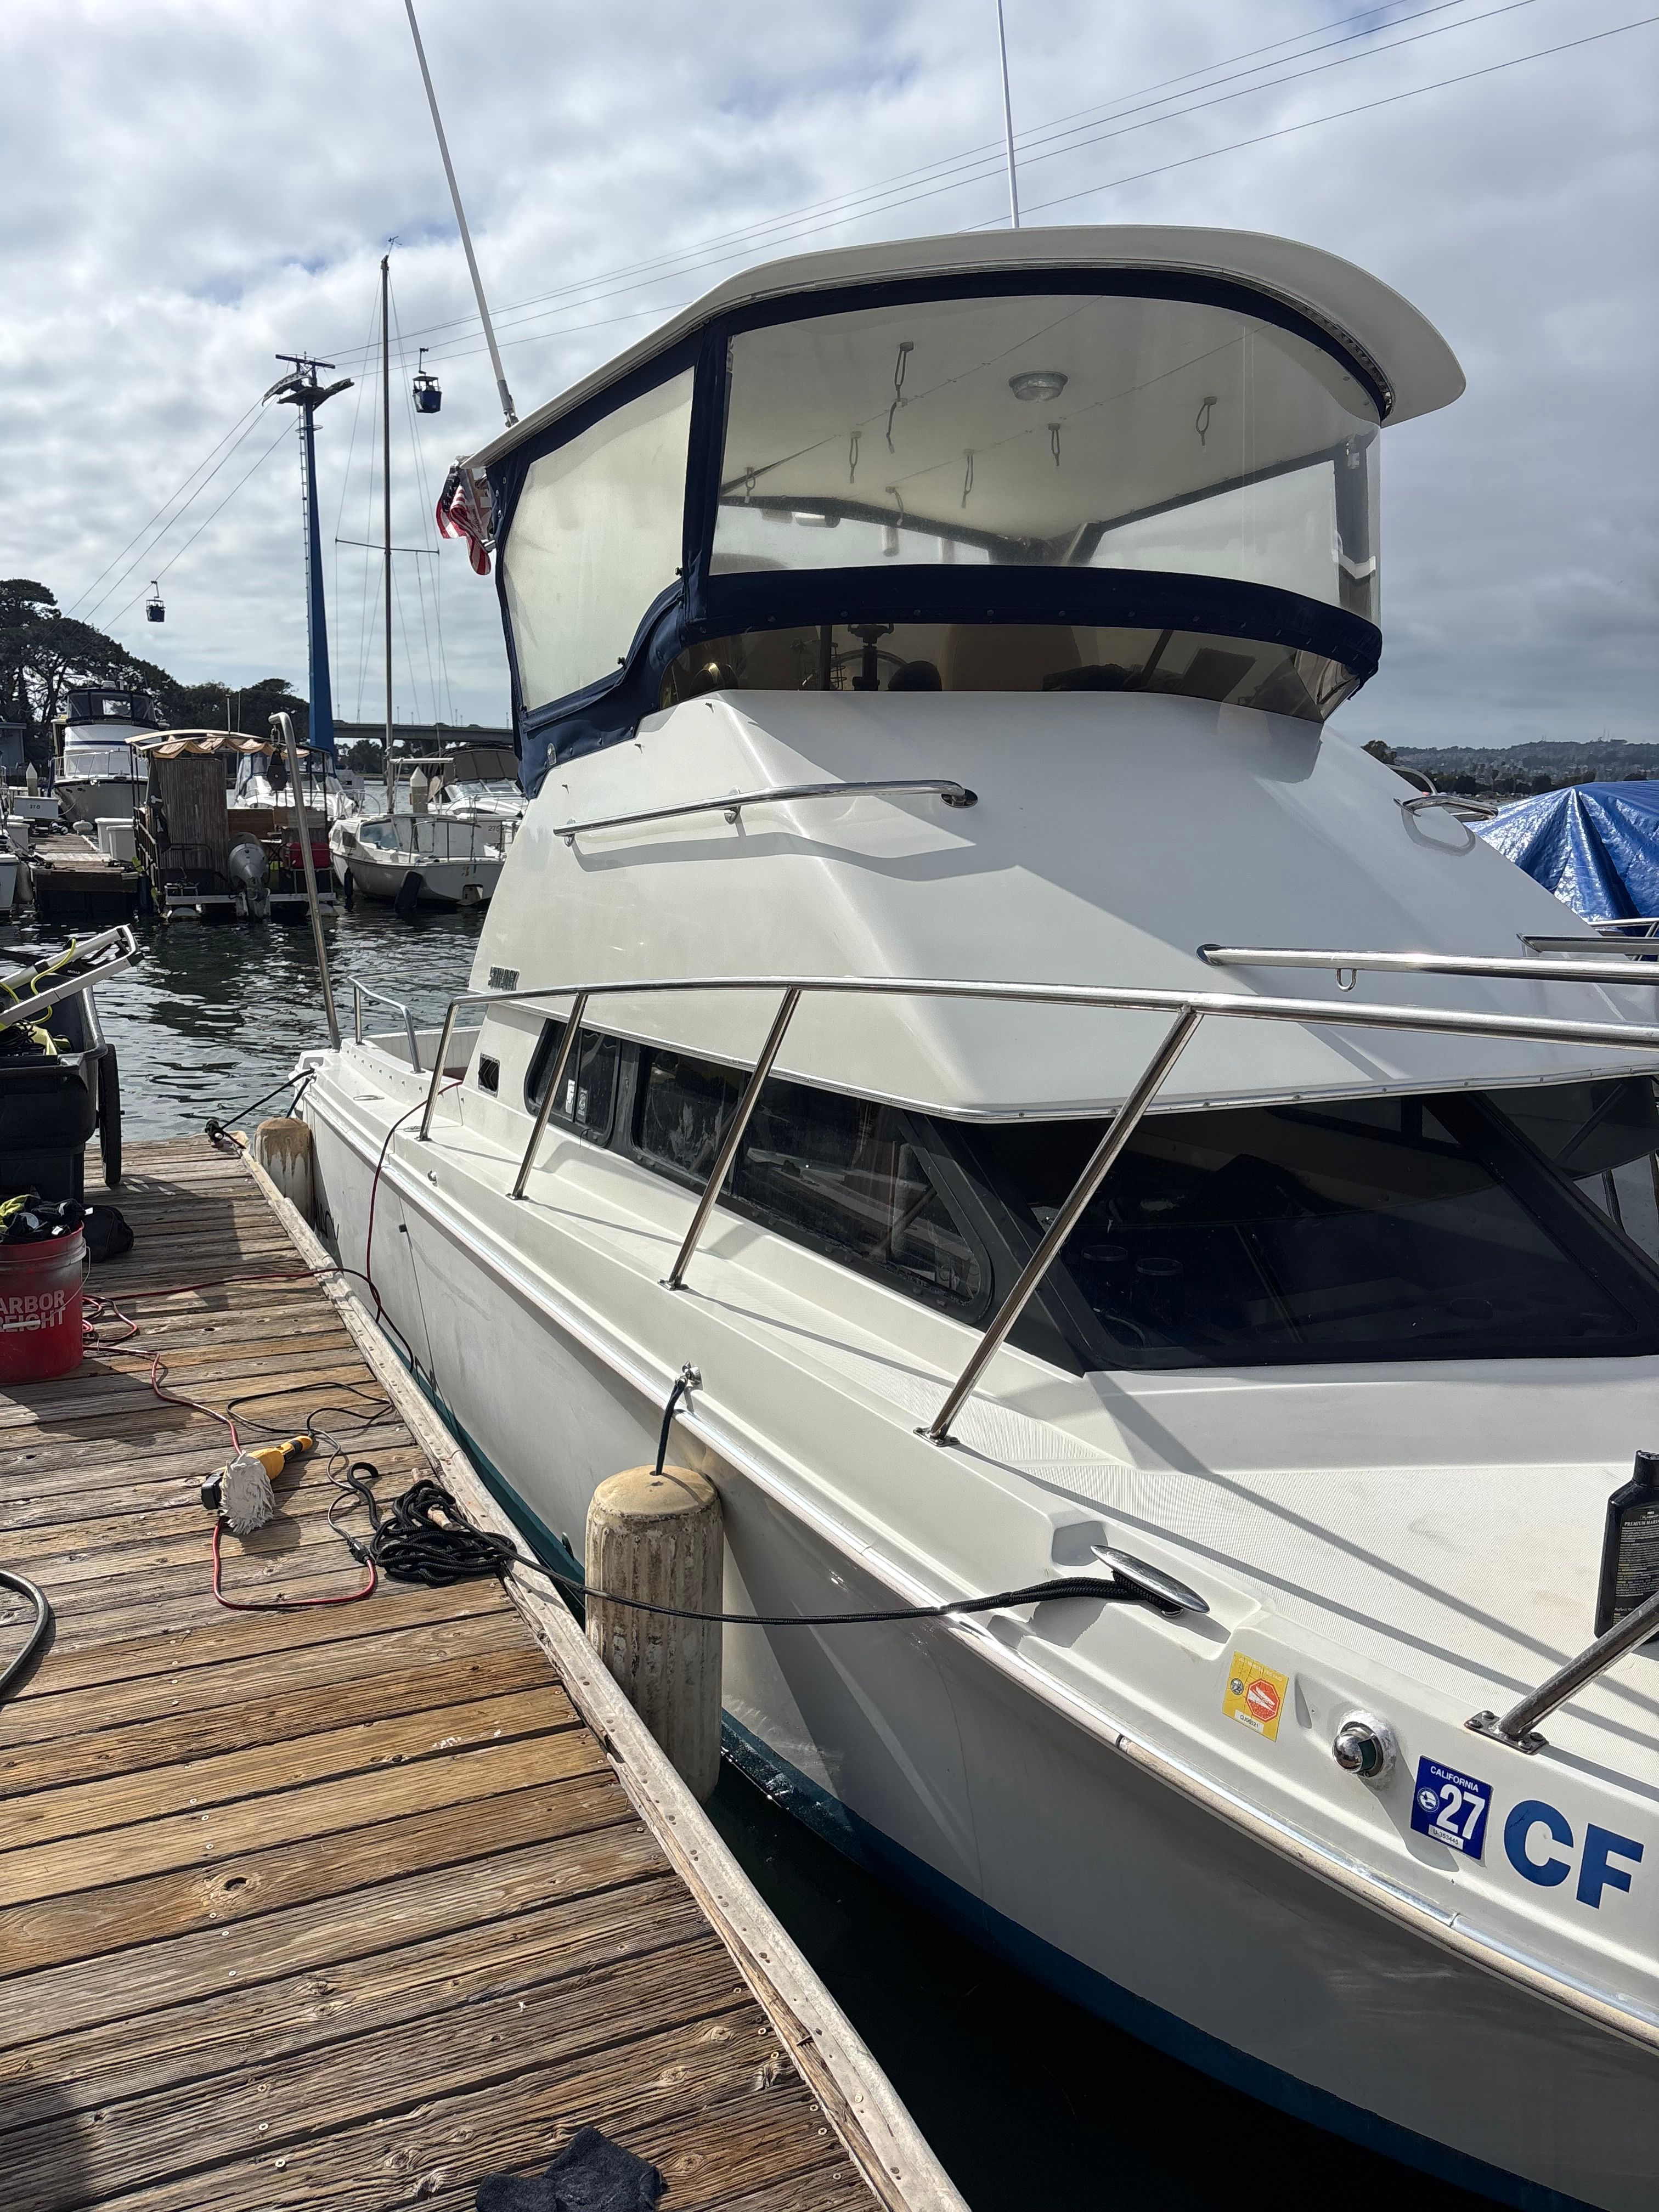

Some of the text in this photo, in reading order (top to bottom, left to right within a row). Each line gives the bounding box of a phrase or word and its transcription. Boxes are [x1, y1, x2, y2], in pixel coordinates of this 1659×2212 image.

[1430, 1765, 1479, 1792] CALIFORNIA
[1436, 1784, 1486, 1840] 27
[1504, 1800, 1644, 1909] CF
